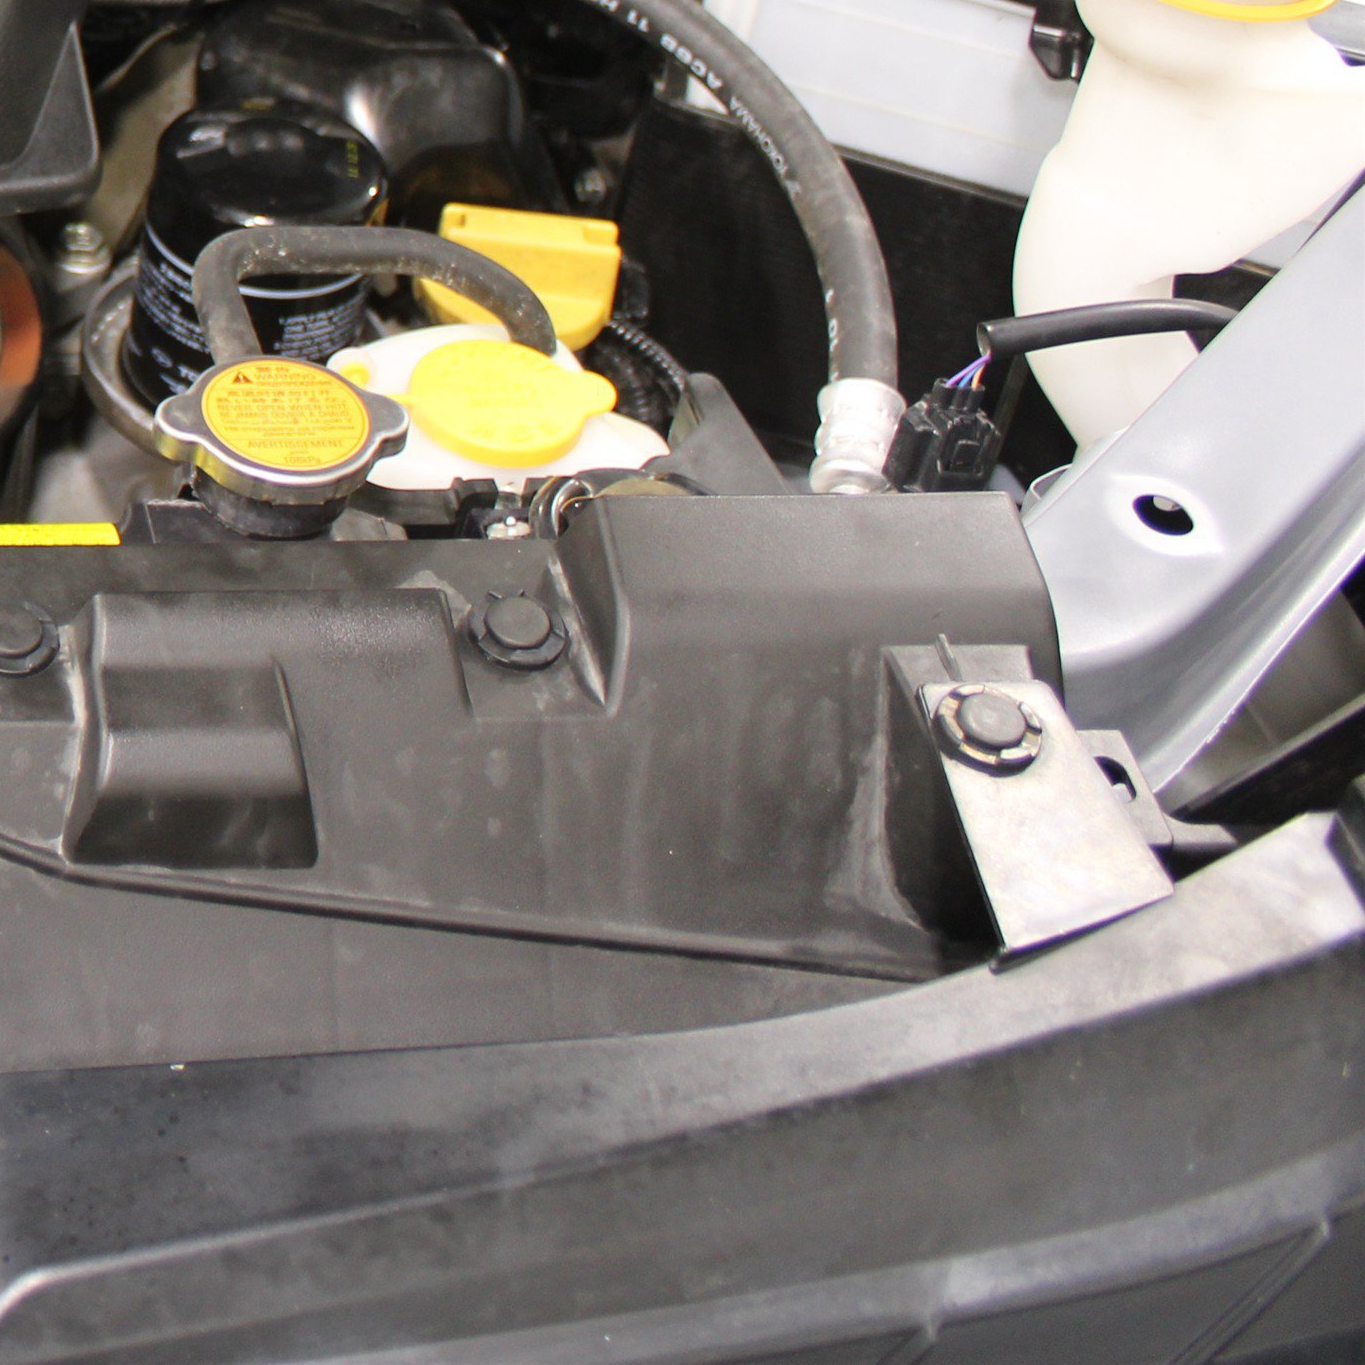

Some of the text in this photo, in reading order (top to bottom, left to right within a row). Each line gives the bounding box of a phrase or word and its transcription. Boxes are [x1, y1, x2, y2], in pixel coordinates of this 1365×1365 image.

[729, 96, 787, 179] YOKOHAMA
[248, 440, 343, 449] AVERTISSEMENT
[284, 456, 321, 465] 108kPa
